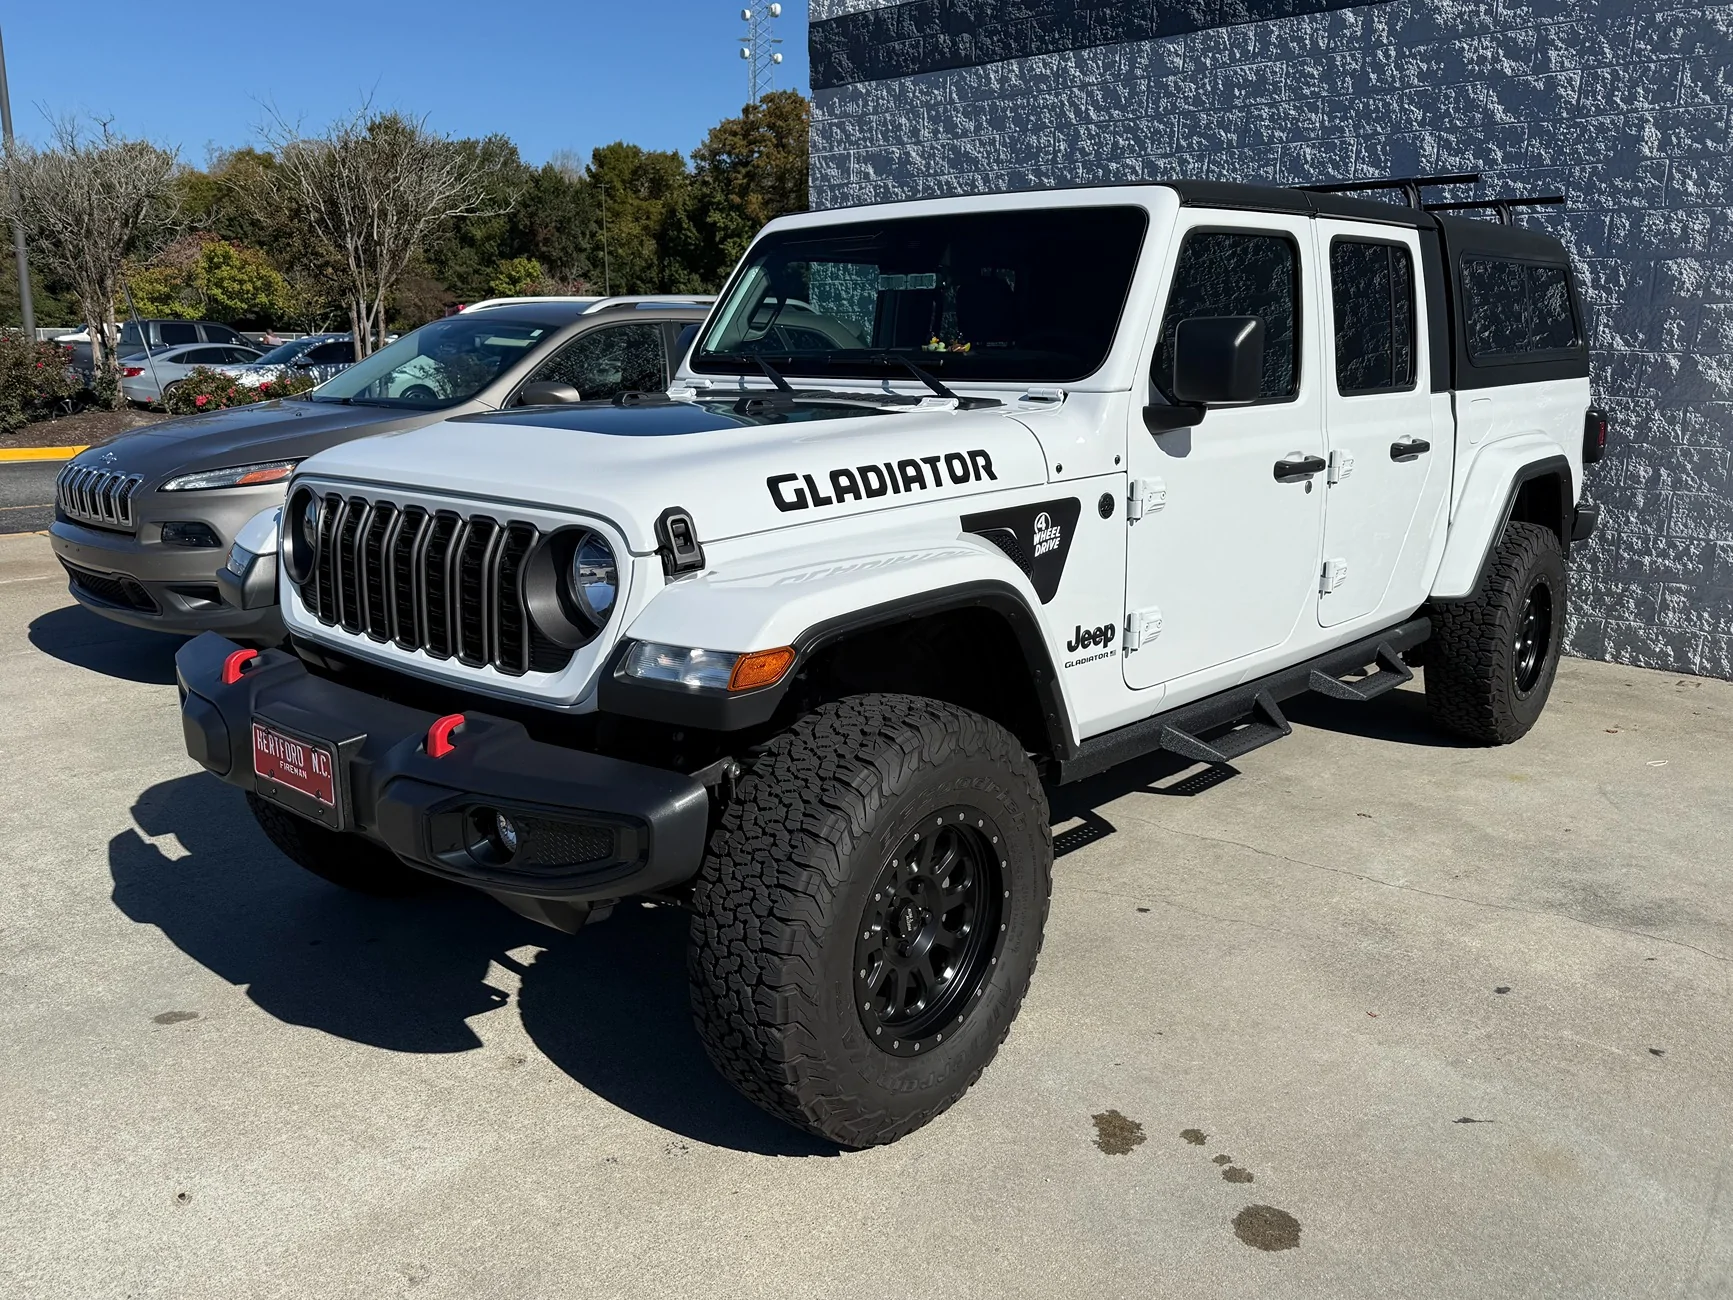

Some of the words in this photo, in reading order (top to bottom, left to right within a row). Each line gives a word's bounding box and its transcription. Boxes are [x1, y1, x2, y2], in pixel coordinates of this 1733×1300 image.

[766, 449, 999, 512] GLADIATOR
[1033, 525, 1061, 546] WHEEL
[1034, 538, 1061, 557] DRIVE
[1066, 622, 1116, 653] Jeep
[1064, 651, 1109, 669] GLADIATOR
[256, 729, 304, 768] HERTFORD
[279, 760, 308, 780] FIREMAN
